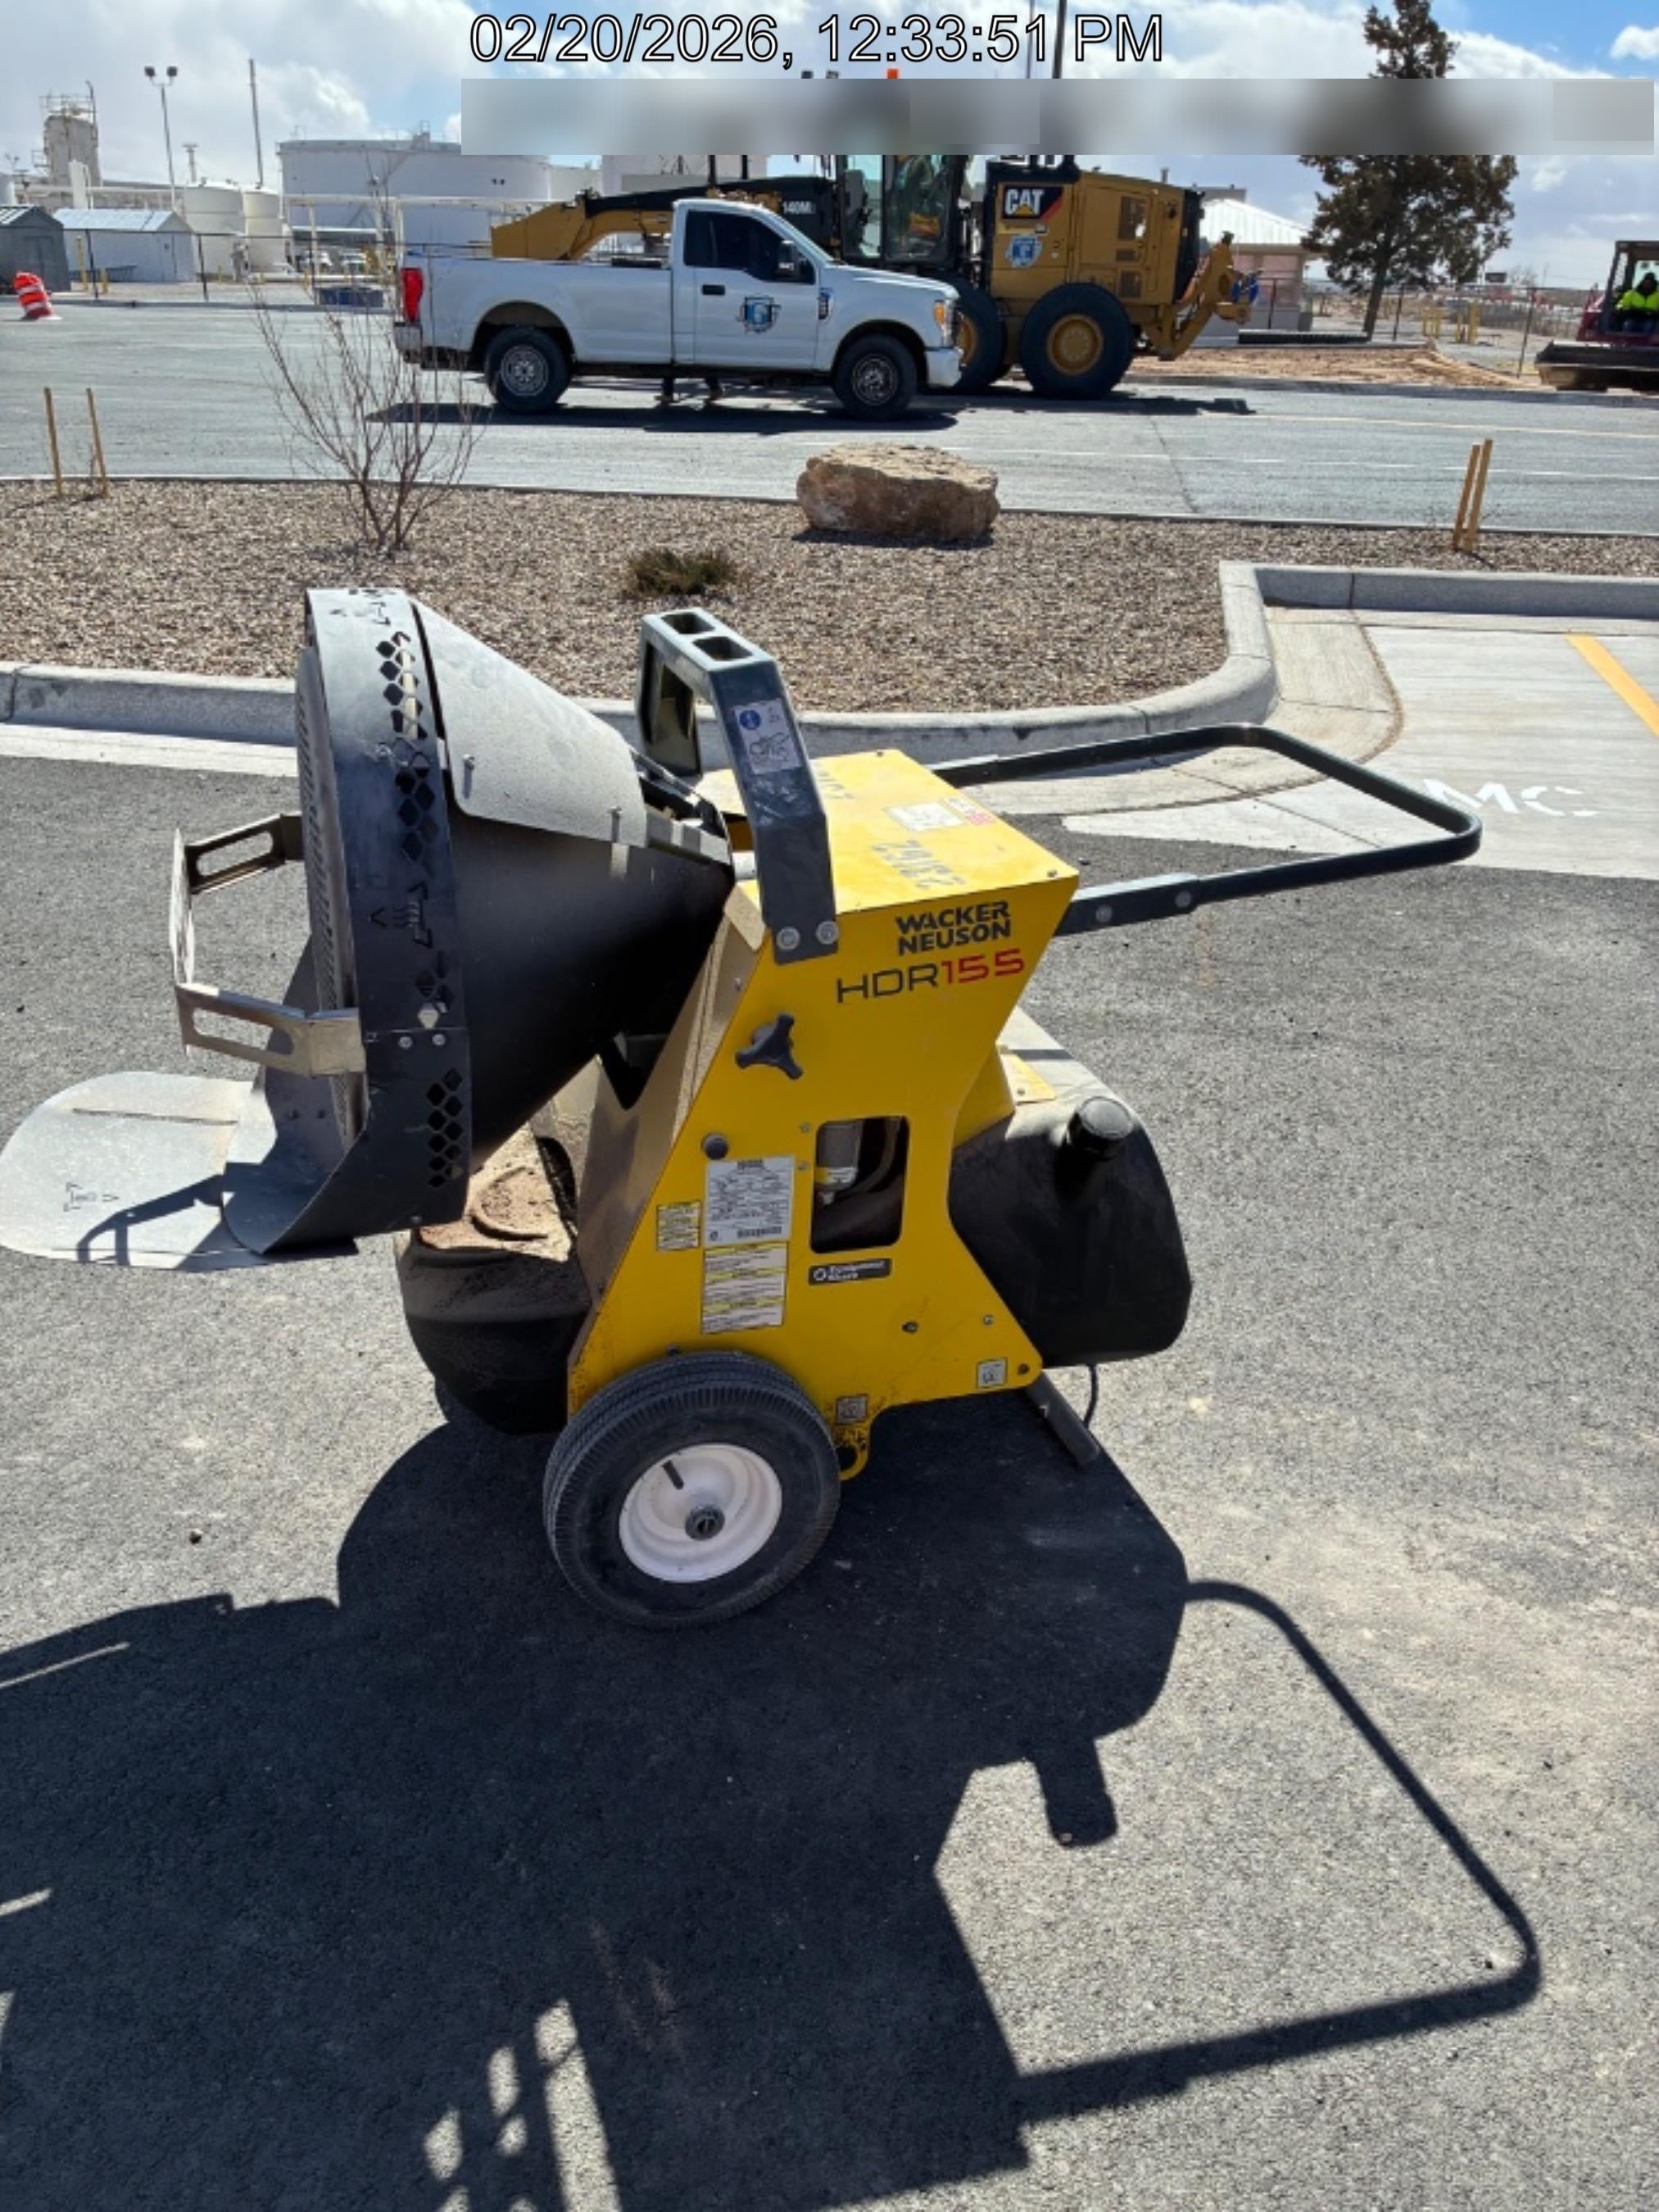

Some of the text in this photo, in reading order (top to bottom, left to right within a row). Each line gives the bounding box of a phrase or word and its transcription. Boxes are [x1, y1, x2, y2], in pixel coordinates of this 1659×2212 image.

[1004, 188, 1045, 216] CAT
[895, 900, 1011, 934] WACKER
[898, 918, 1011, 956] NEUSON
[837, 948, 1025, 1004] HDR155
